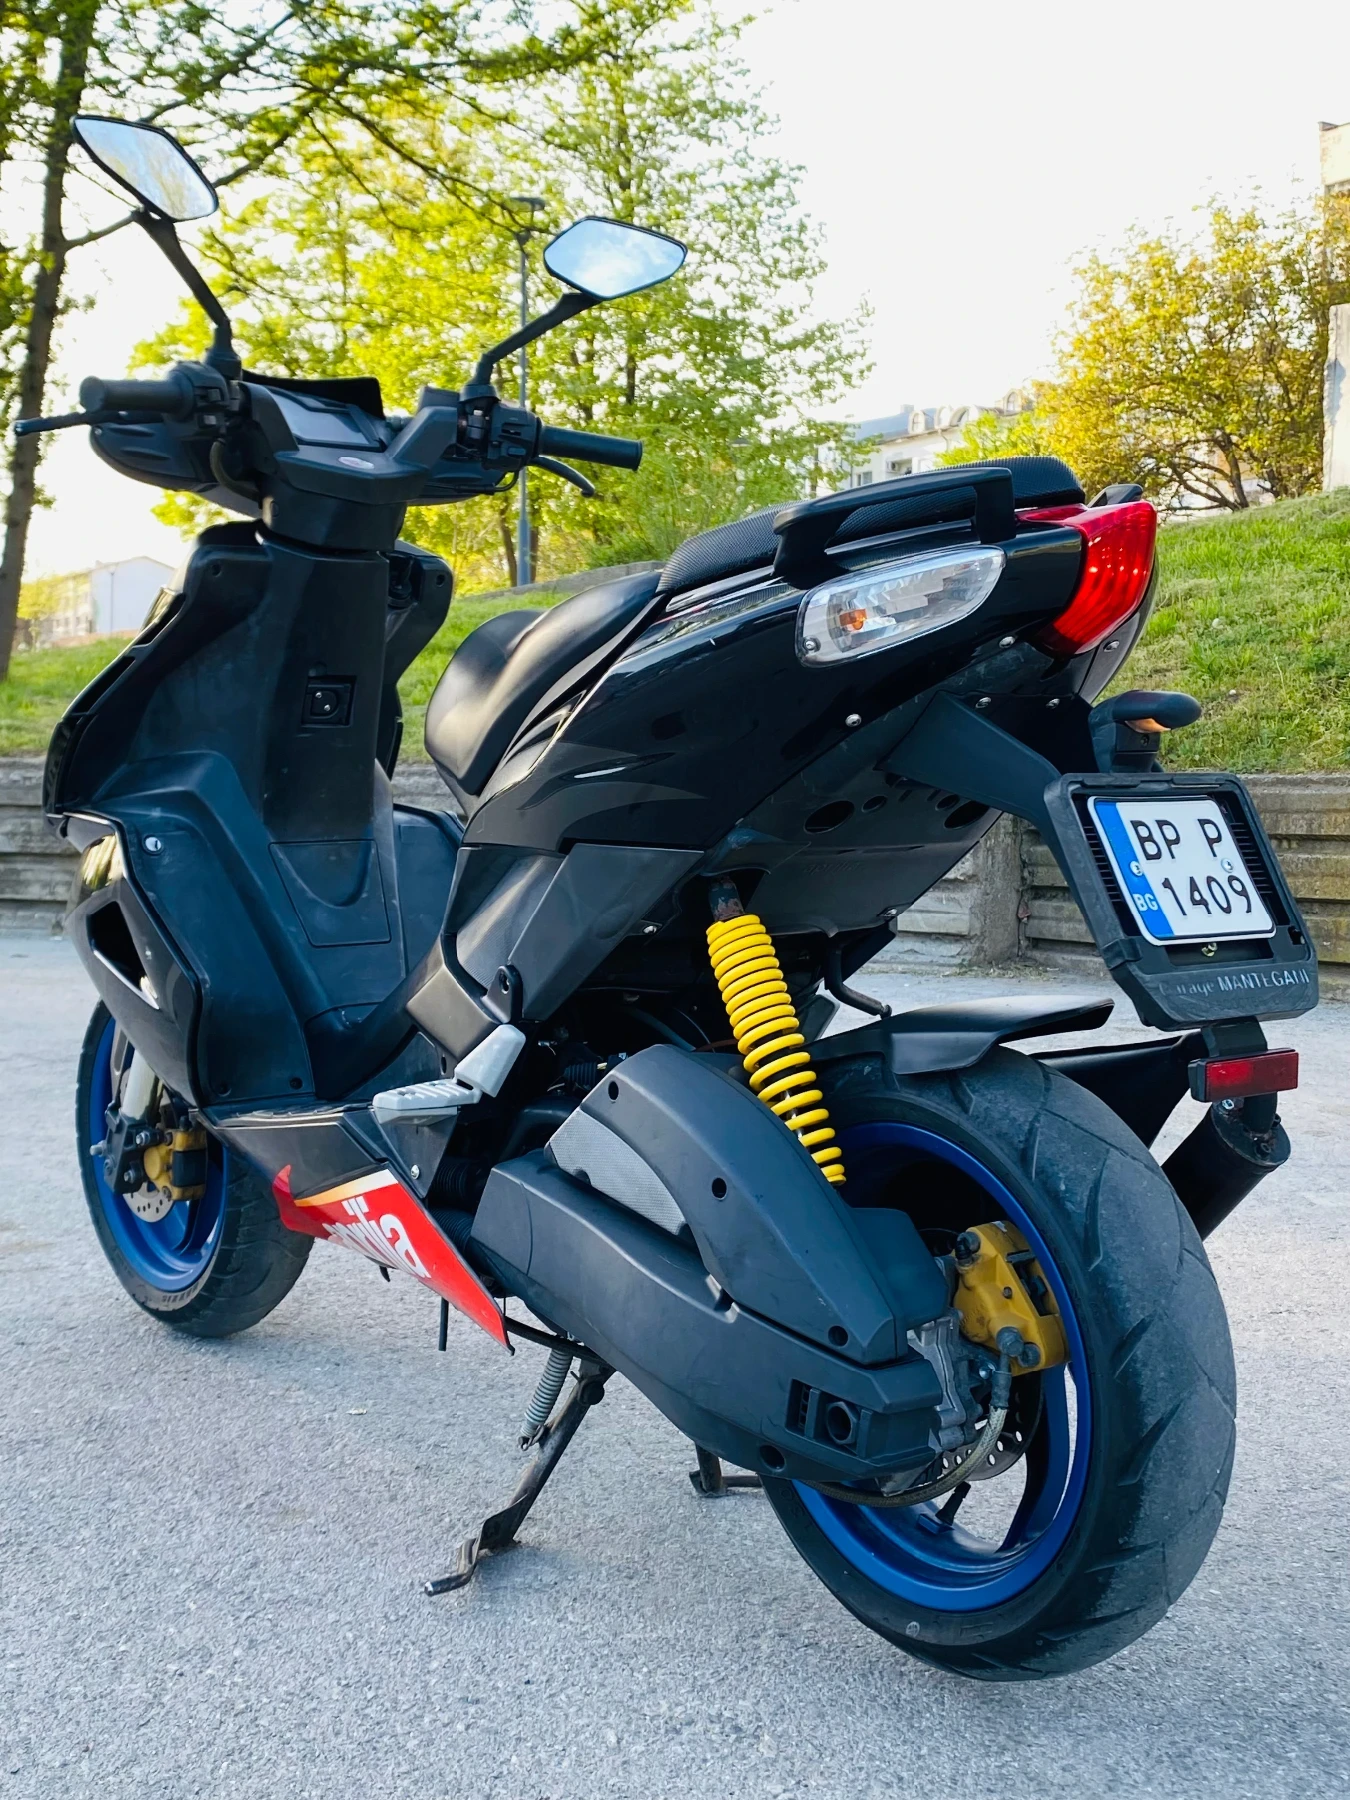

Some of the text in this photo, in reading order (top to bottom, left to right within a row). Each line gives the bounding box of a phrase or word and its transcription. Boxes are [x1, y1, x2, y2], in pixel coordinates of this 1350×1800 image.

[1130, 818, 1222, 861] BP P
[1132, 893, 1159, 912] BG
[1161, 874, 1252, 916] 1409
